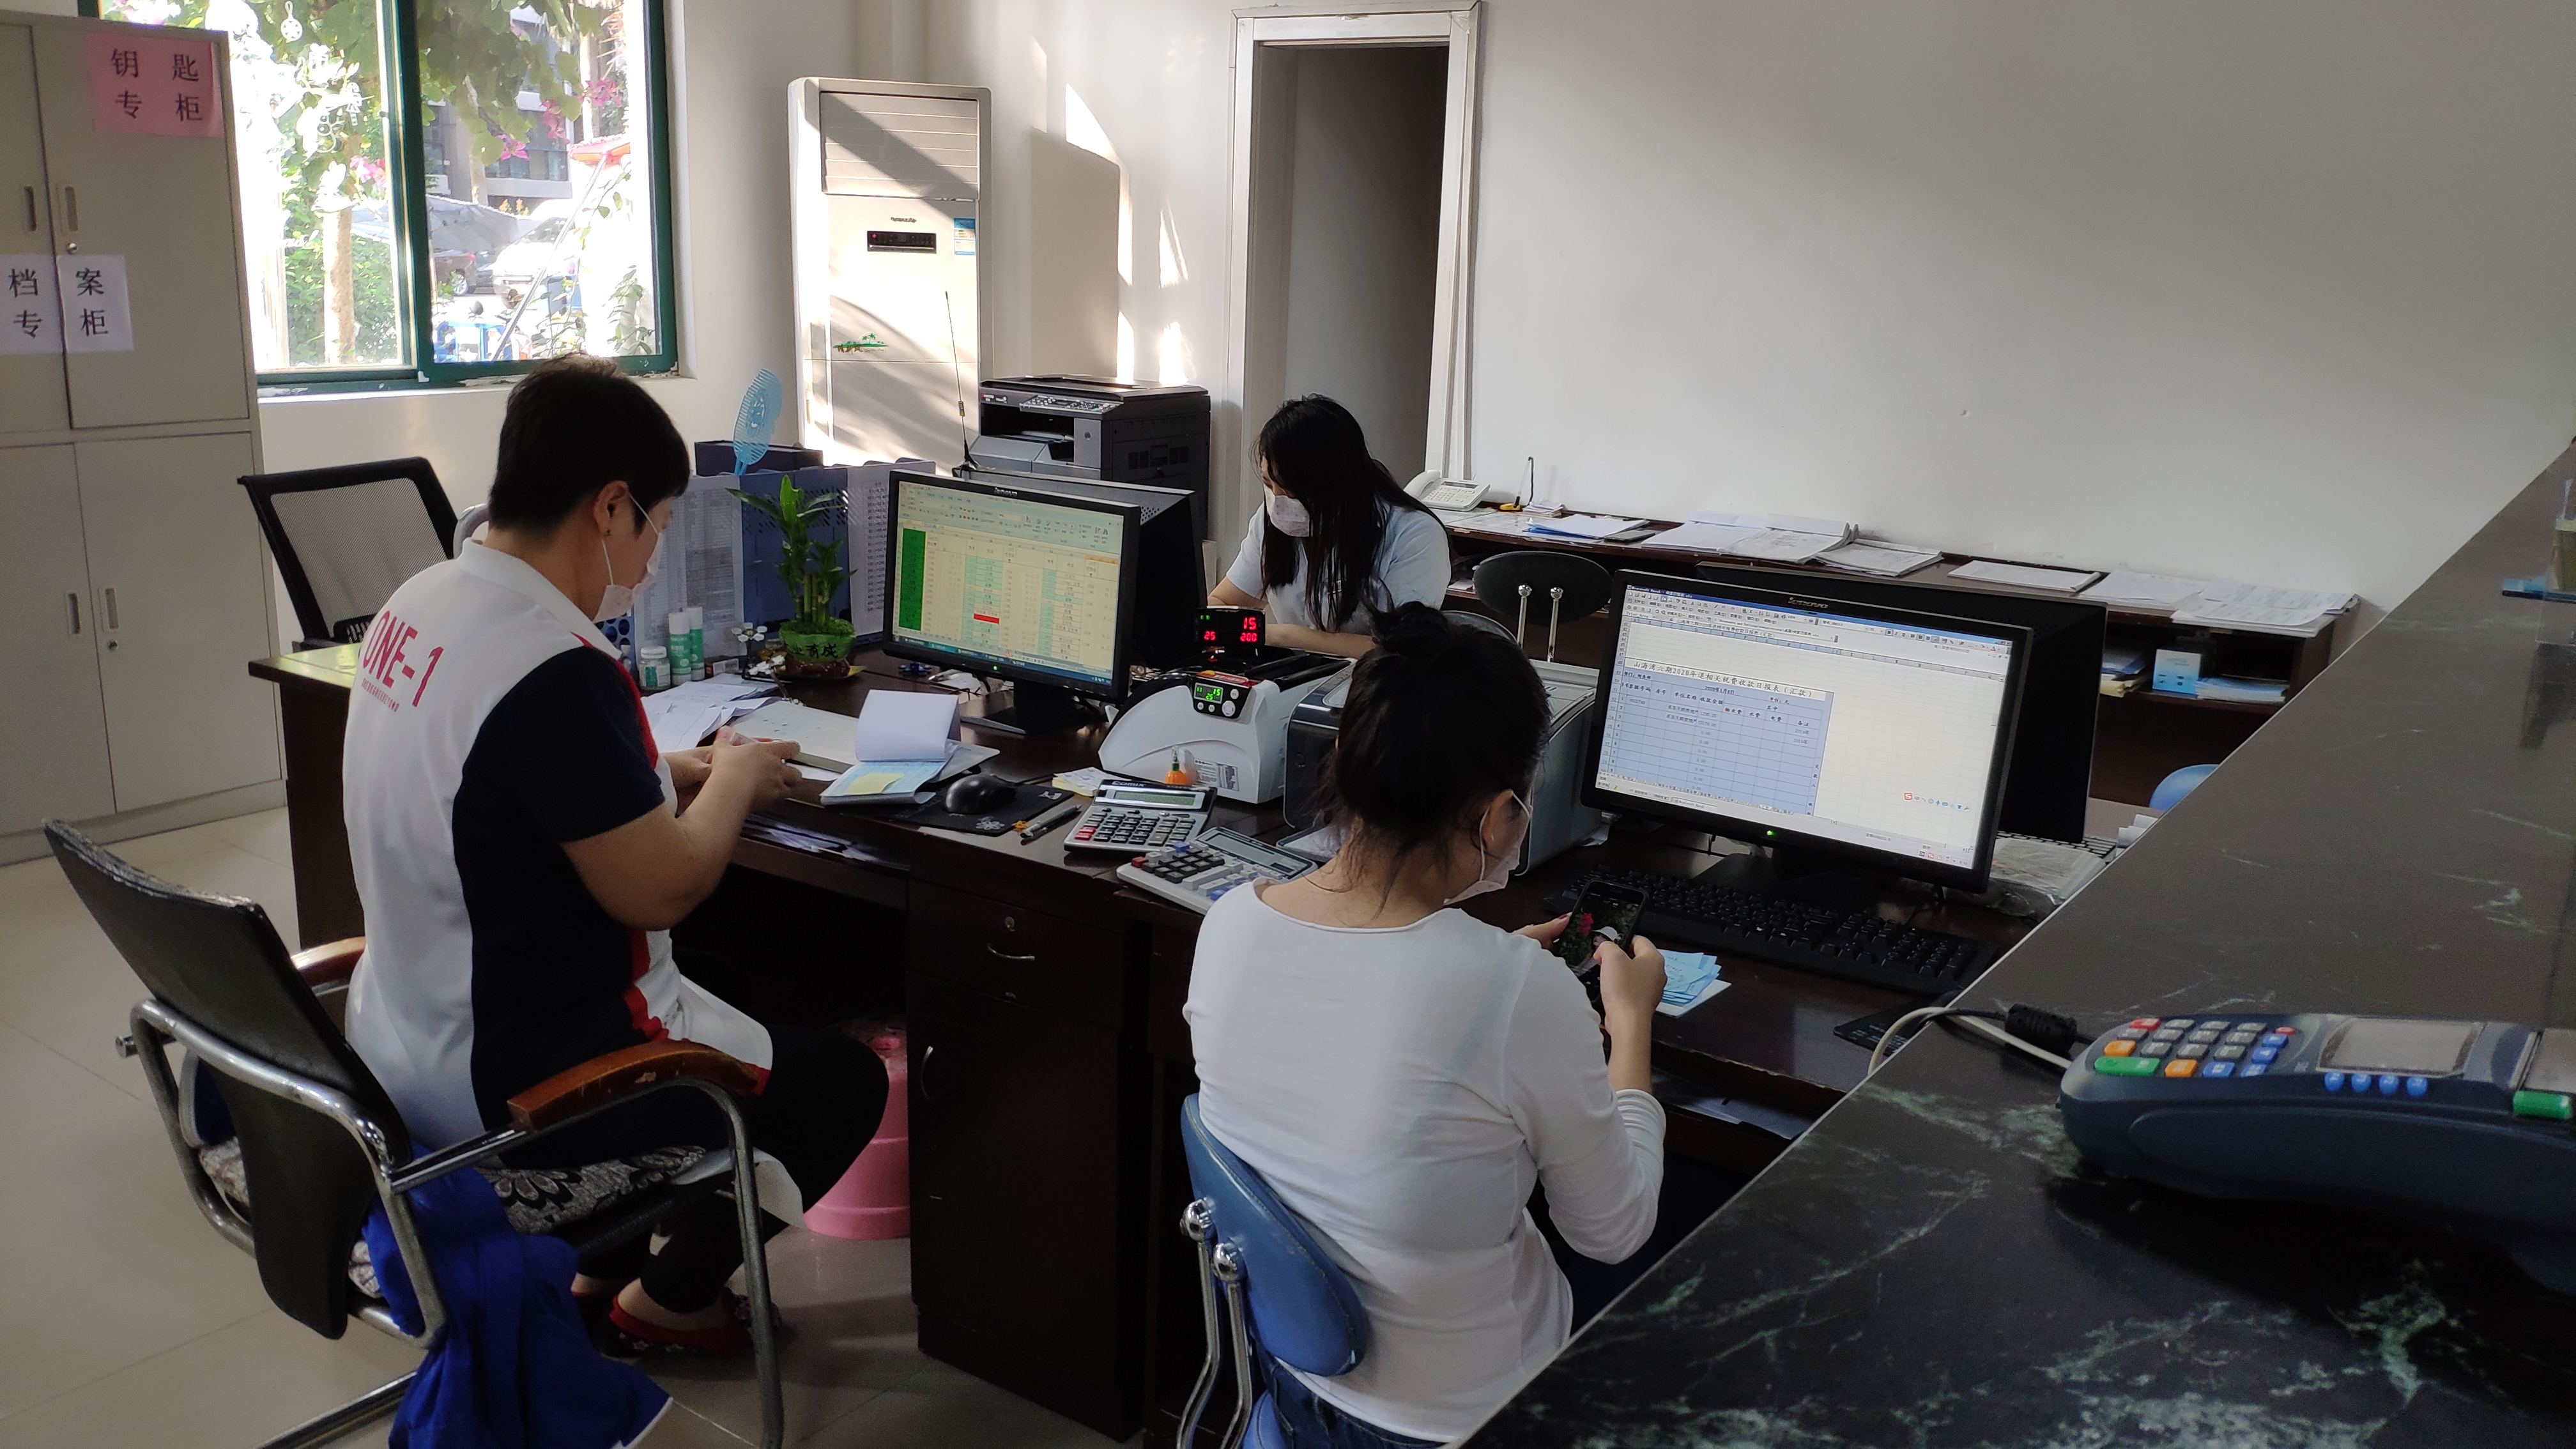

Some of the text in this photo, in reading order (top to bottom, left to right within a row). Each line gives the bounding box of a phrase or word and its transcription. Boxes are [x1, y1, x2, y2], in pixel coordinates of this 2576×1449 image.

[1243, 616, 1257, 631] 15
[1204, 631, 1258, 642] 25 200
[363, 610, 443, 707] ONE-1
